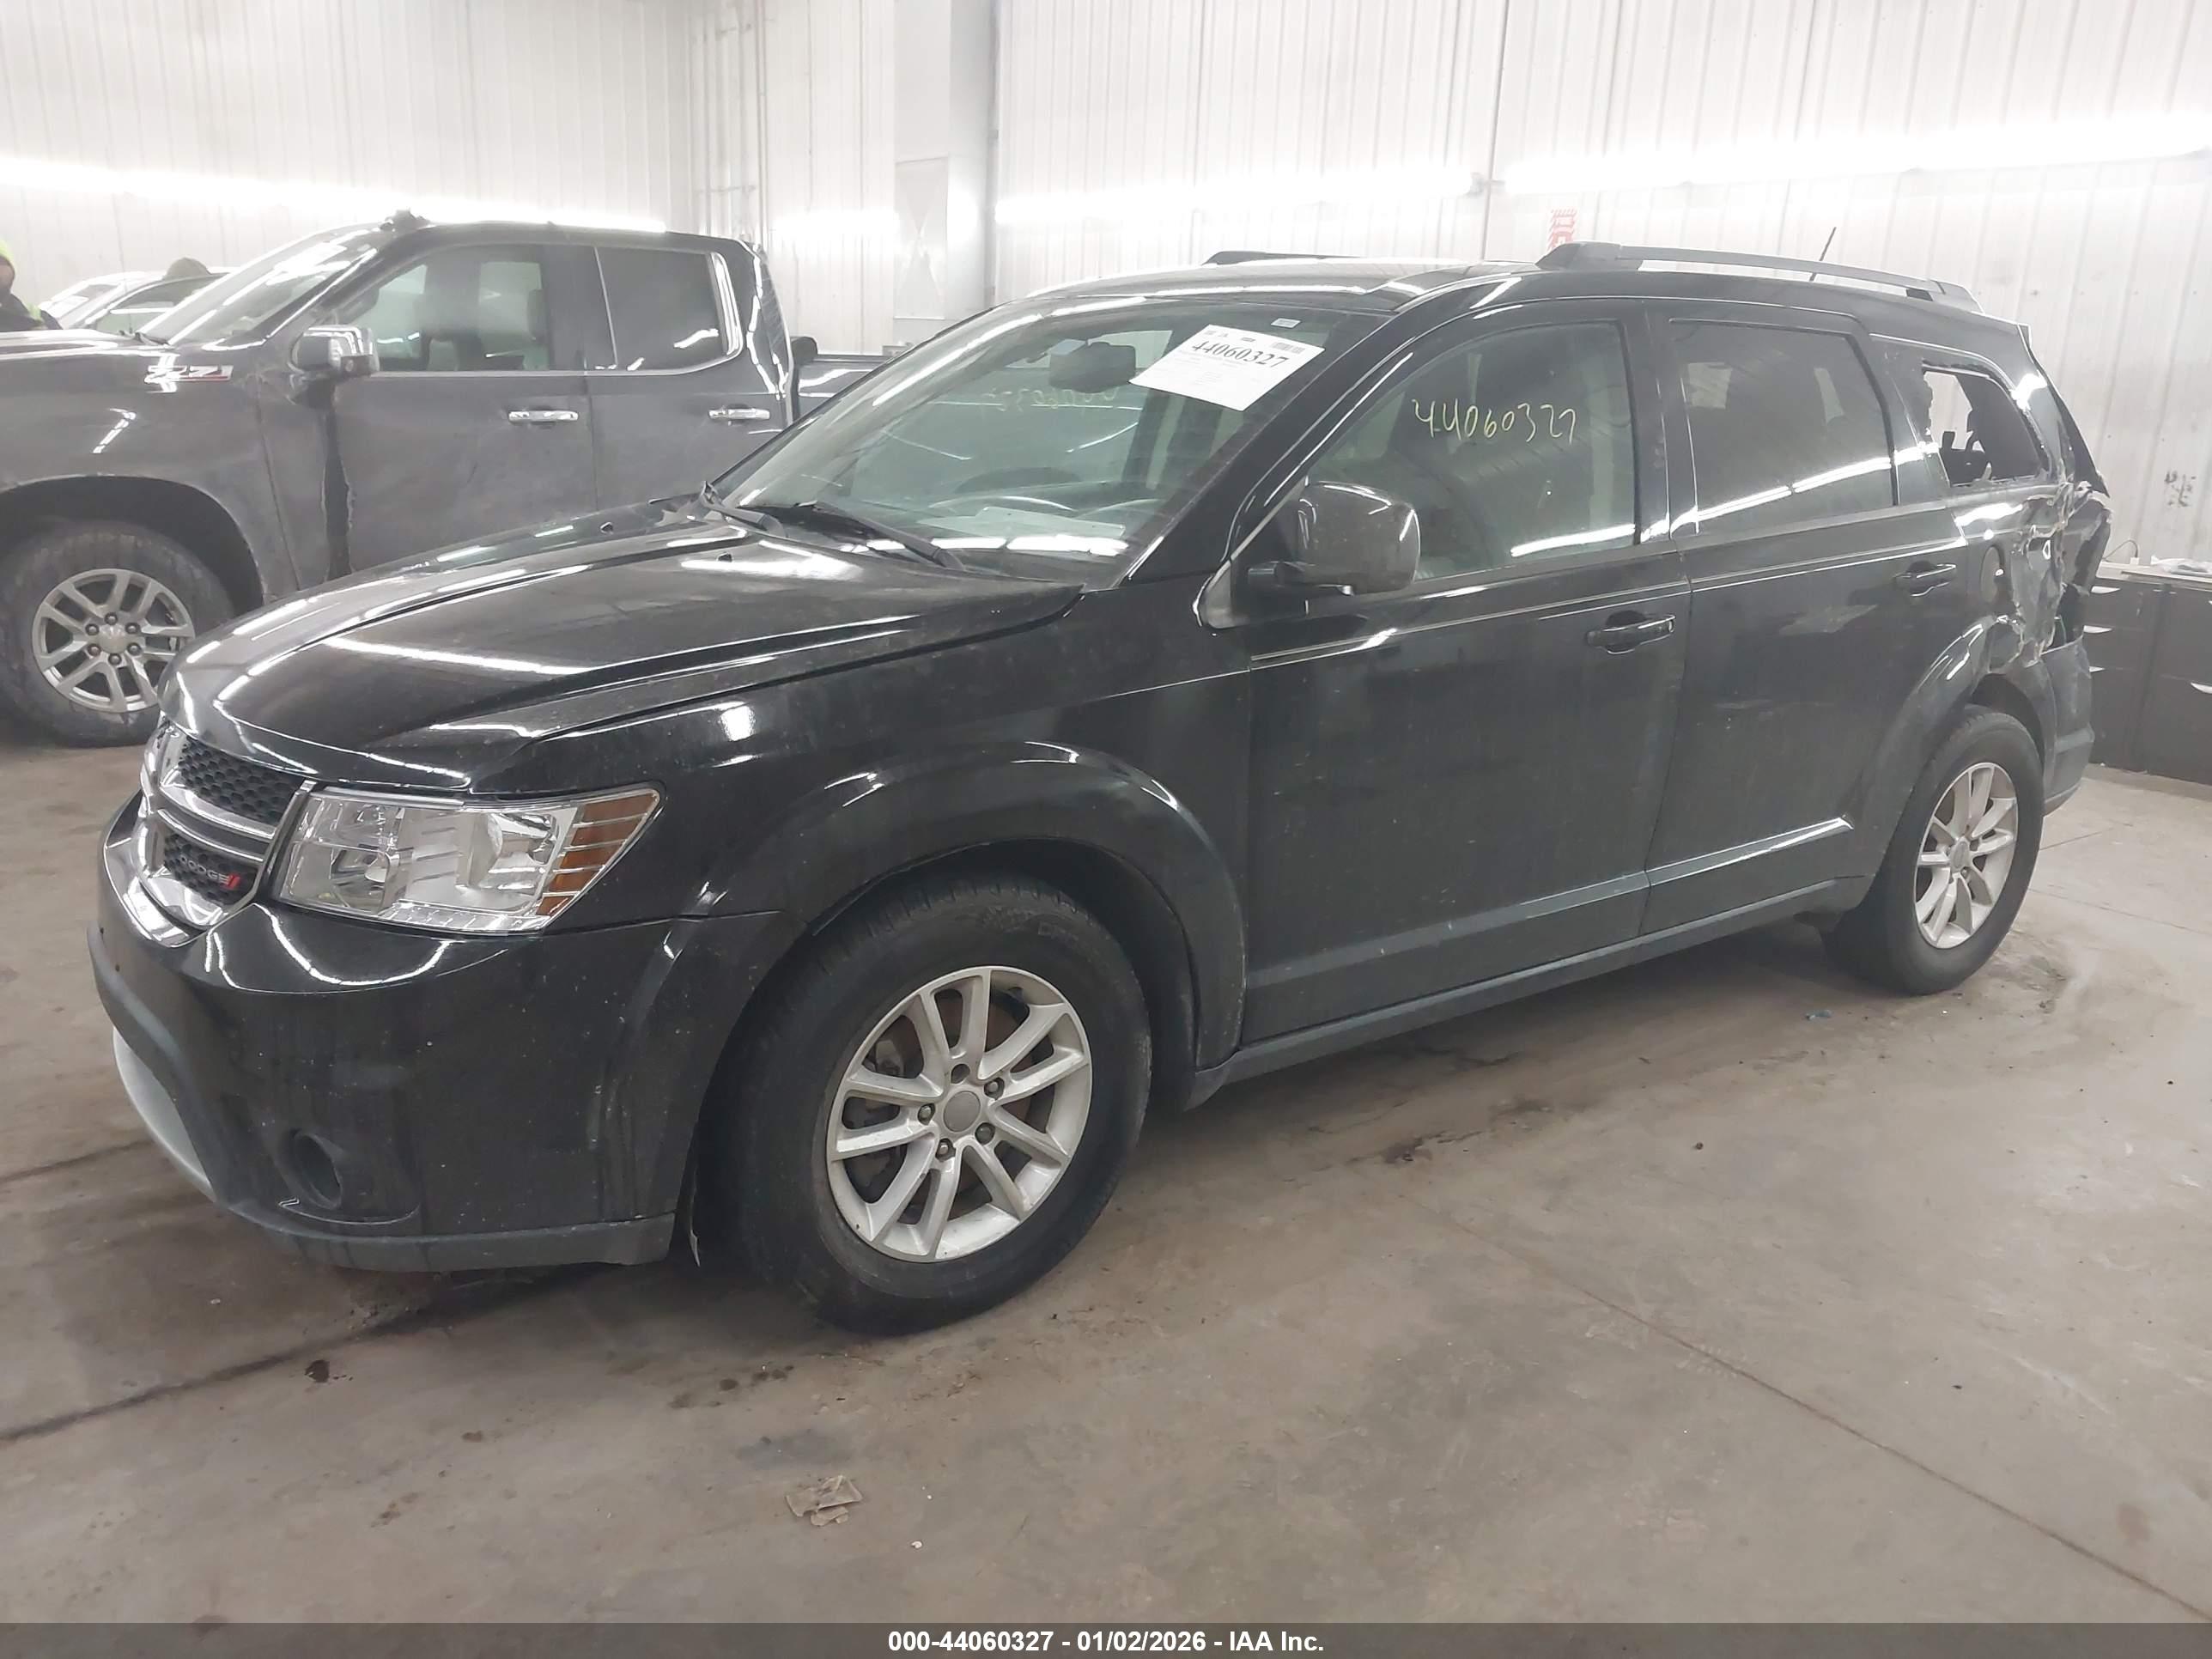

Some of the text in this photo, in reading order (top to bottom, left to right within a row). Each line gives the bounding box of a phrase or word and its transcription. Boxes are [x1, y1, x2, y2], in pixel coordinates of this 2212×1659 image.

[1191, 340, 1290, 368] 44060327
[1411, 398, 1577, 445] 44060327
[179, 855, 230, 886] DODGE
